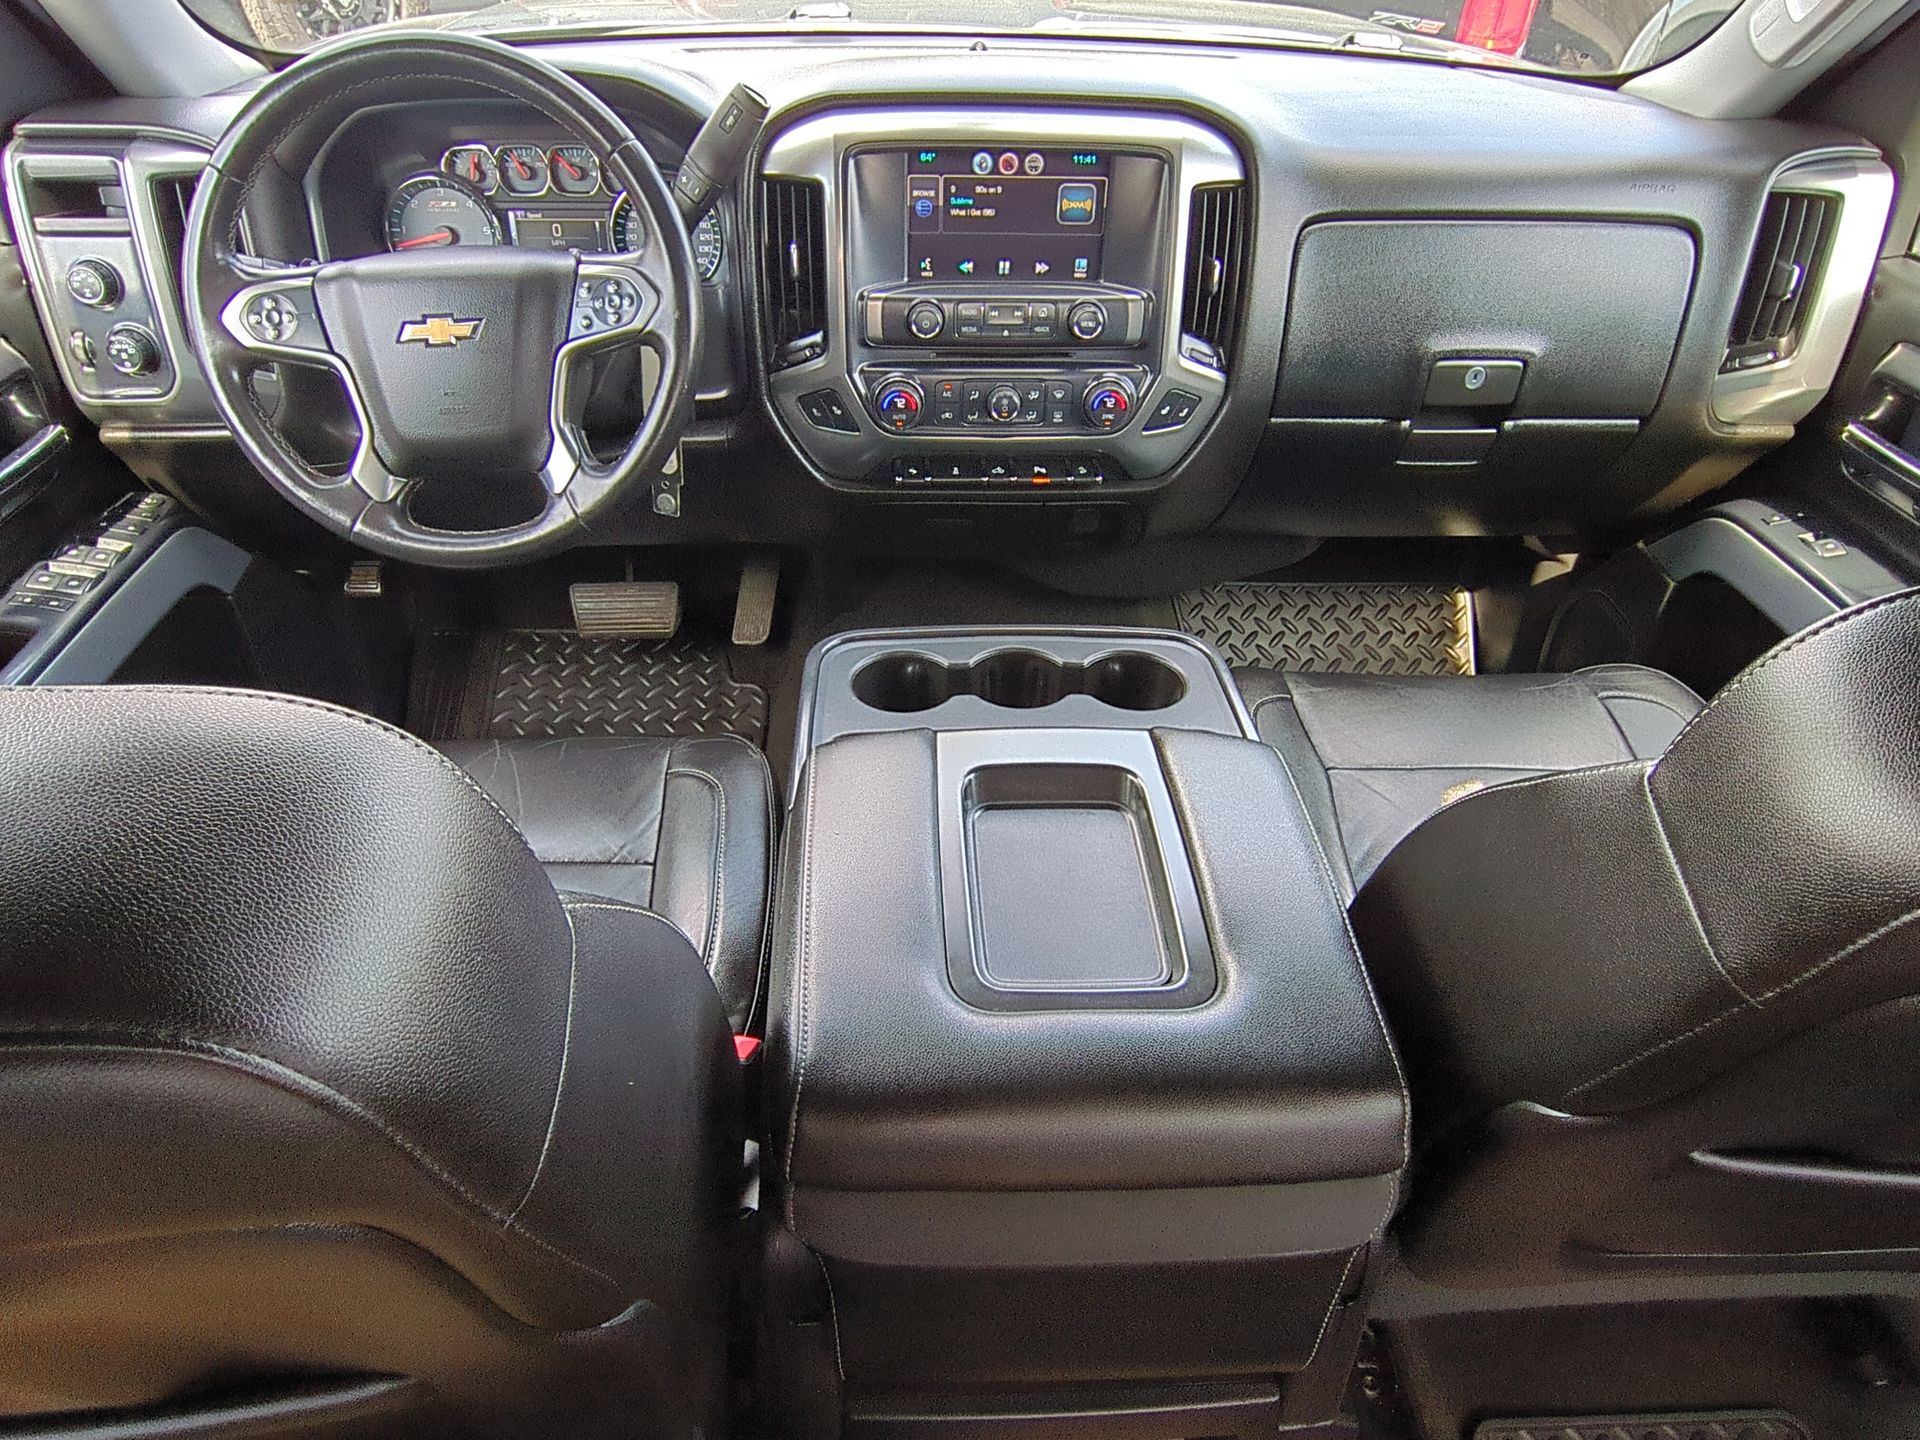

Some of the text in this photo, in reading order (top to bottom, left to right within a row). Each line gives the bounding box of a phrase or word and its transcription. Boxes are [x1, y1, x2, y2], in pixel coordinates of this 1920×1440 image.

[1072, 154, 1097, 165] 11:41
[436, 188, 444, 197] 3
[410, 200, 419, 209] 2
[465, 200, 473, 209] 4
[625, 221, 638, 229] 30
[551, 223, 562, 238] 0
[625, 233, 638, 241] 20
[699, 233, 714, 241] 120
[698, 245, 713, 253] 130
[1080, 320, 1096, 328] MENU
[961, 325, 977, 333] MEDIA
[894, 397, 906, 409] 72
[1103, 397, 1116, 408] 72
